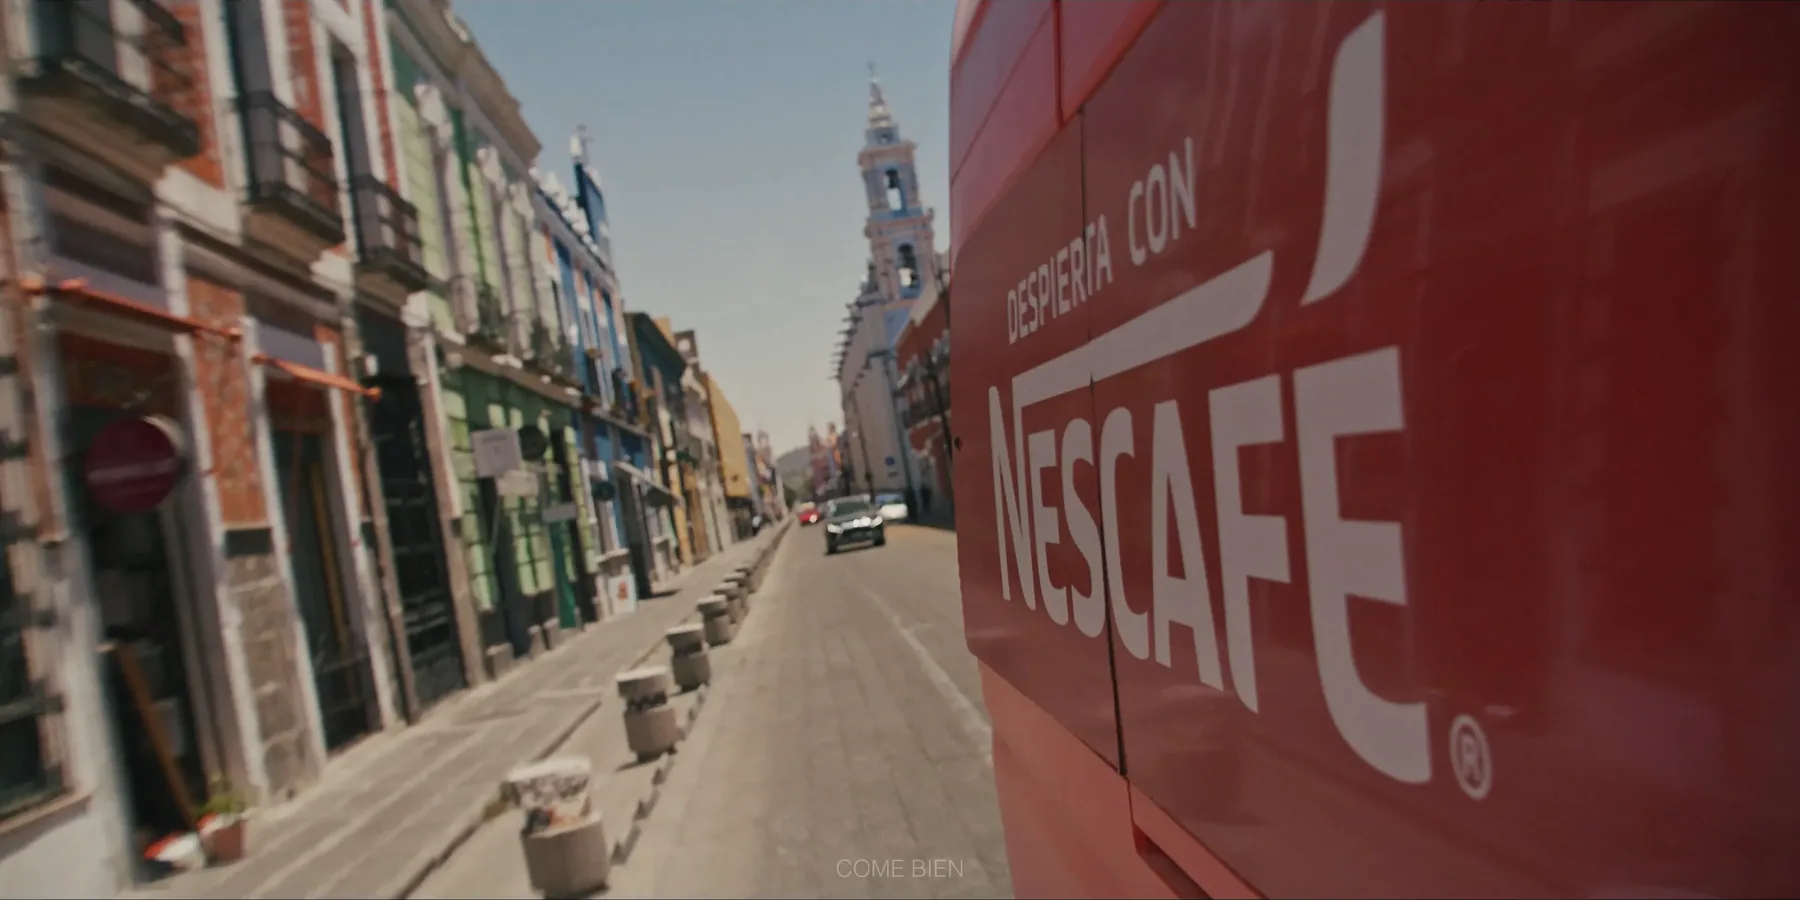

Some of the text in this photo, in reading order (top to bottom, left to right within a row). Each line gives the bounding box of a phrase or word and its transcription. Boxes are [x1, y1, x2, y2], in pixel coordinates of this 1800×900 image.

[989, 9, 1432, 784] NESCAFÉ
[1007, 136, 1196, 344] DESPIERTA CON
